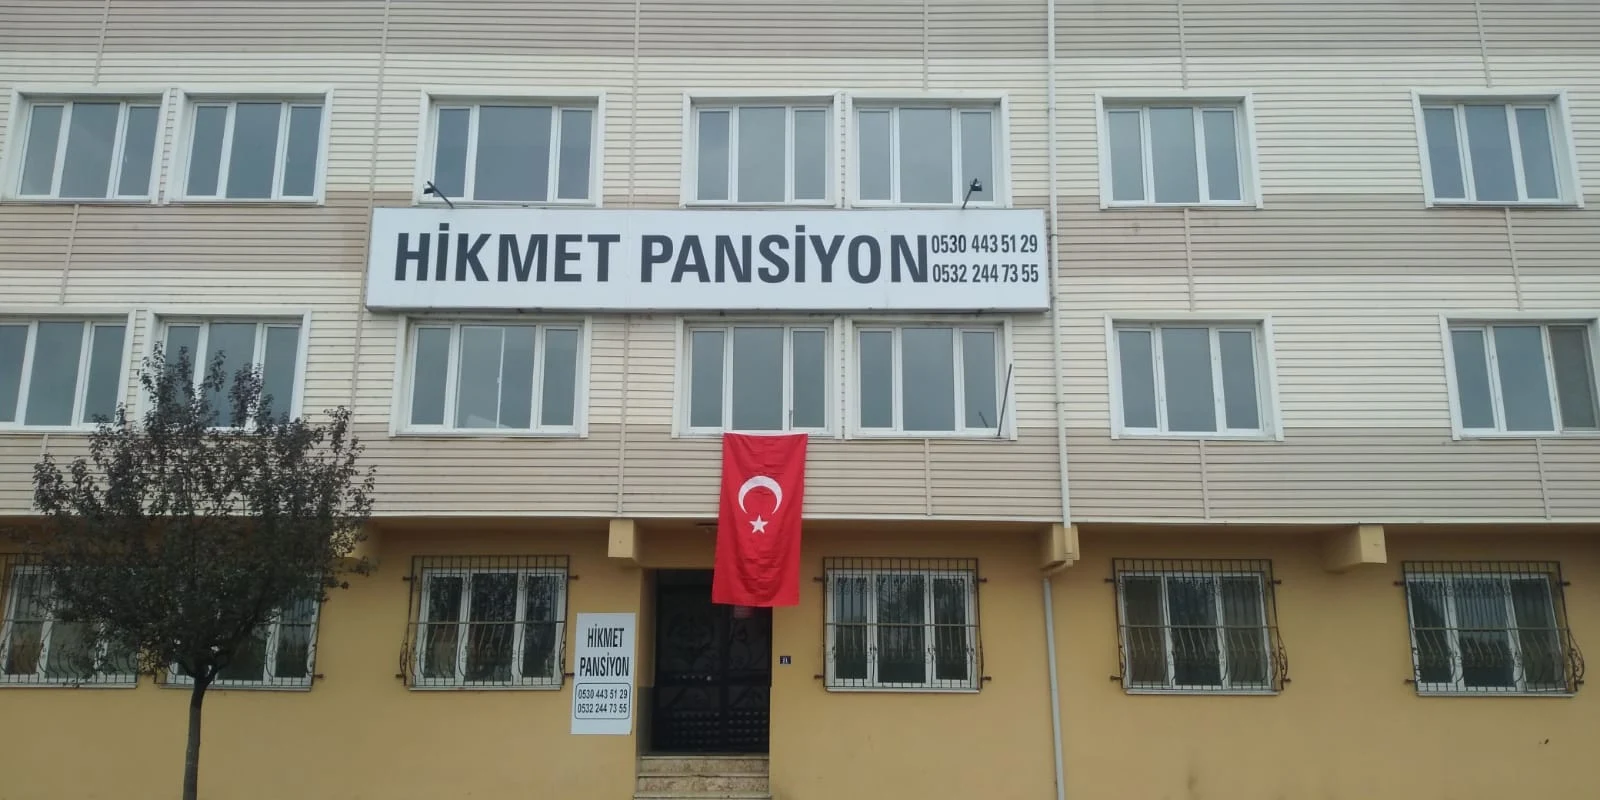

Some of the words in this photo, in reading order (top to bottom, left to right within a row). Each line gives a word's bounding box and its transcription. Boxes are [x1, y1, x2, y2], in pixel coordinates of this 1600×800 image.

[931, 234, 967, 253] 0530
[971, 234, 998, 253] 443
[1001, 234, 1016, 253] 51
[1020, 234, 1038, 253] 29
[395, 223, 620, 282] HİKMET
[640, 224, 928, 284] PANSİYON
[932, 264, 967, 283] 0532
[972, 264, 998, 283] 244
[1002, 264, 1018, 283] 73
[1021, 264, 1039, 283] 55
[587, 623, 625, 648] HİKMET
[579, 652, 630, 676] PANSİYON
[578, 689, 594, 699] 0530
[595, 689, 608, 699] 443
[609, 689, 617, 699] 51
[619, 689, 628, 699] 29
[577, 703, 593, 713] 0532
[595, 703, 607, 713] 244
[609, 703, 617, 713] 73
[619, 703, 627, 713] 55
